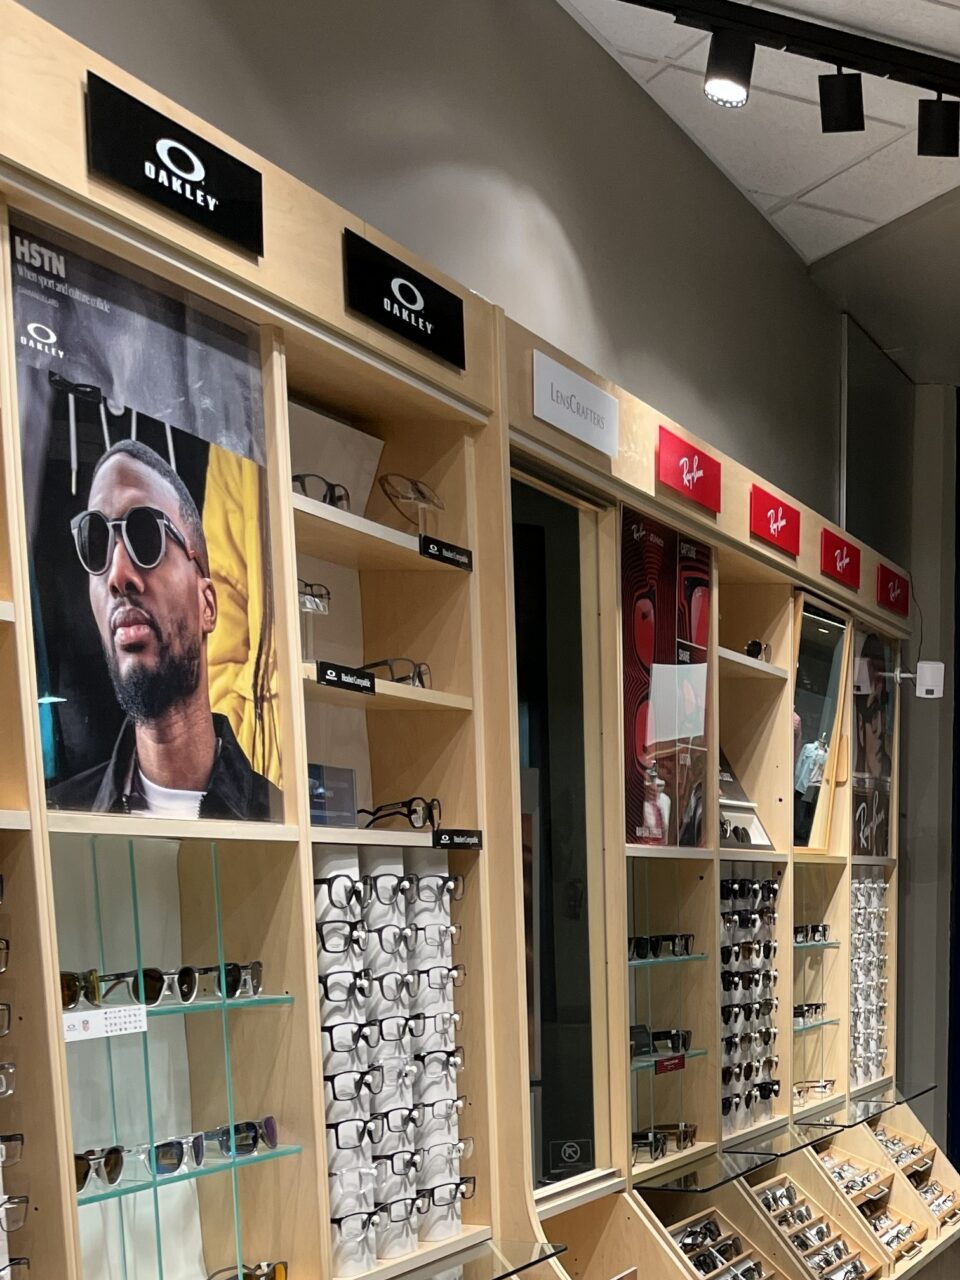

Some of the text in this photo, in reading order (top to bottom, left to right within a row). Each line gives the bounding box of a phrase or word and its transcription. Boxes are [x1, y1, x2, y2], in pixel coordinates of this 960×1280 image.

[144, 160, 217, 212] OAKLEY
[15, 236, 66, 279] HSTN
[383, 297, 432, 335] OAKLEY
[20, 335, 65, 359] OAKLEY
